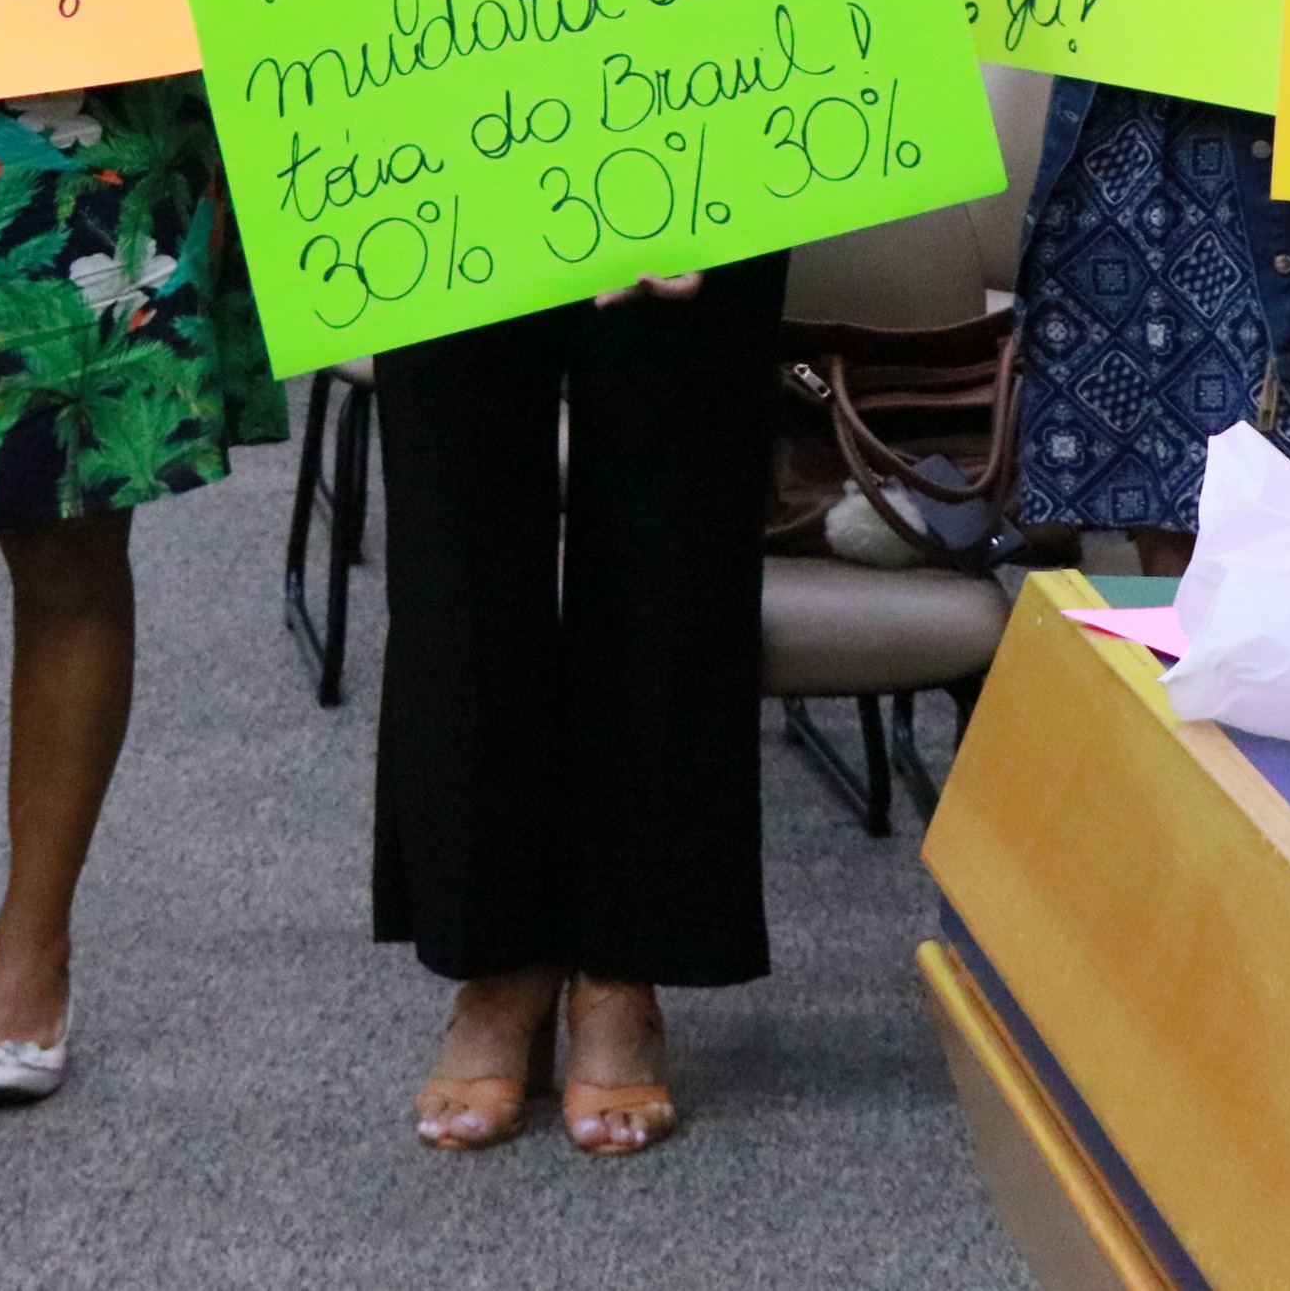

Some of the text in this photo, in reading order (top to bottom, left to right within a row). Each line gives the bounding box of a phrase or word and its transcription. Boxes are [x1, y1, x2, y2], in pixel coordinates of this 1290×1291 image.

[300, 78, 922, 328] 30% 30% 30%
[472, 90, 571, 159] do
